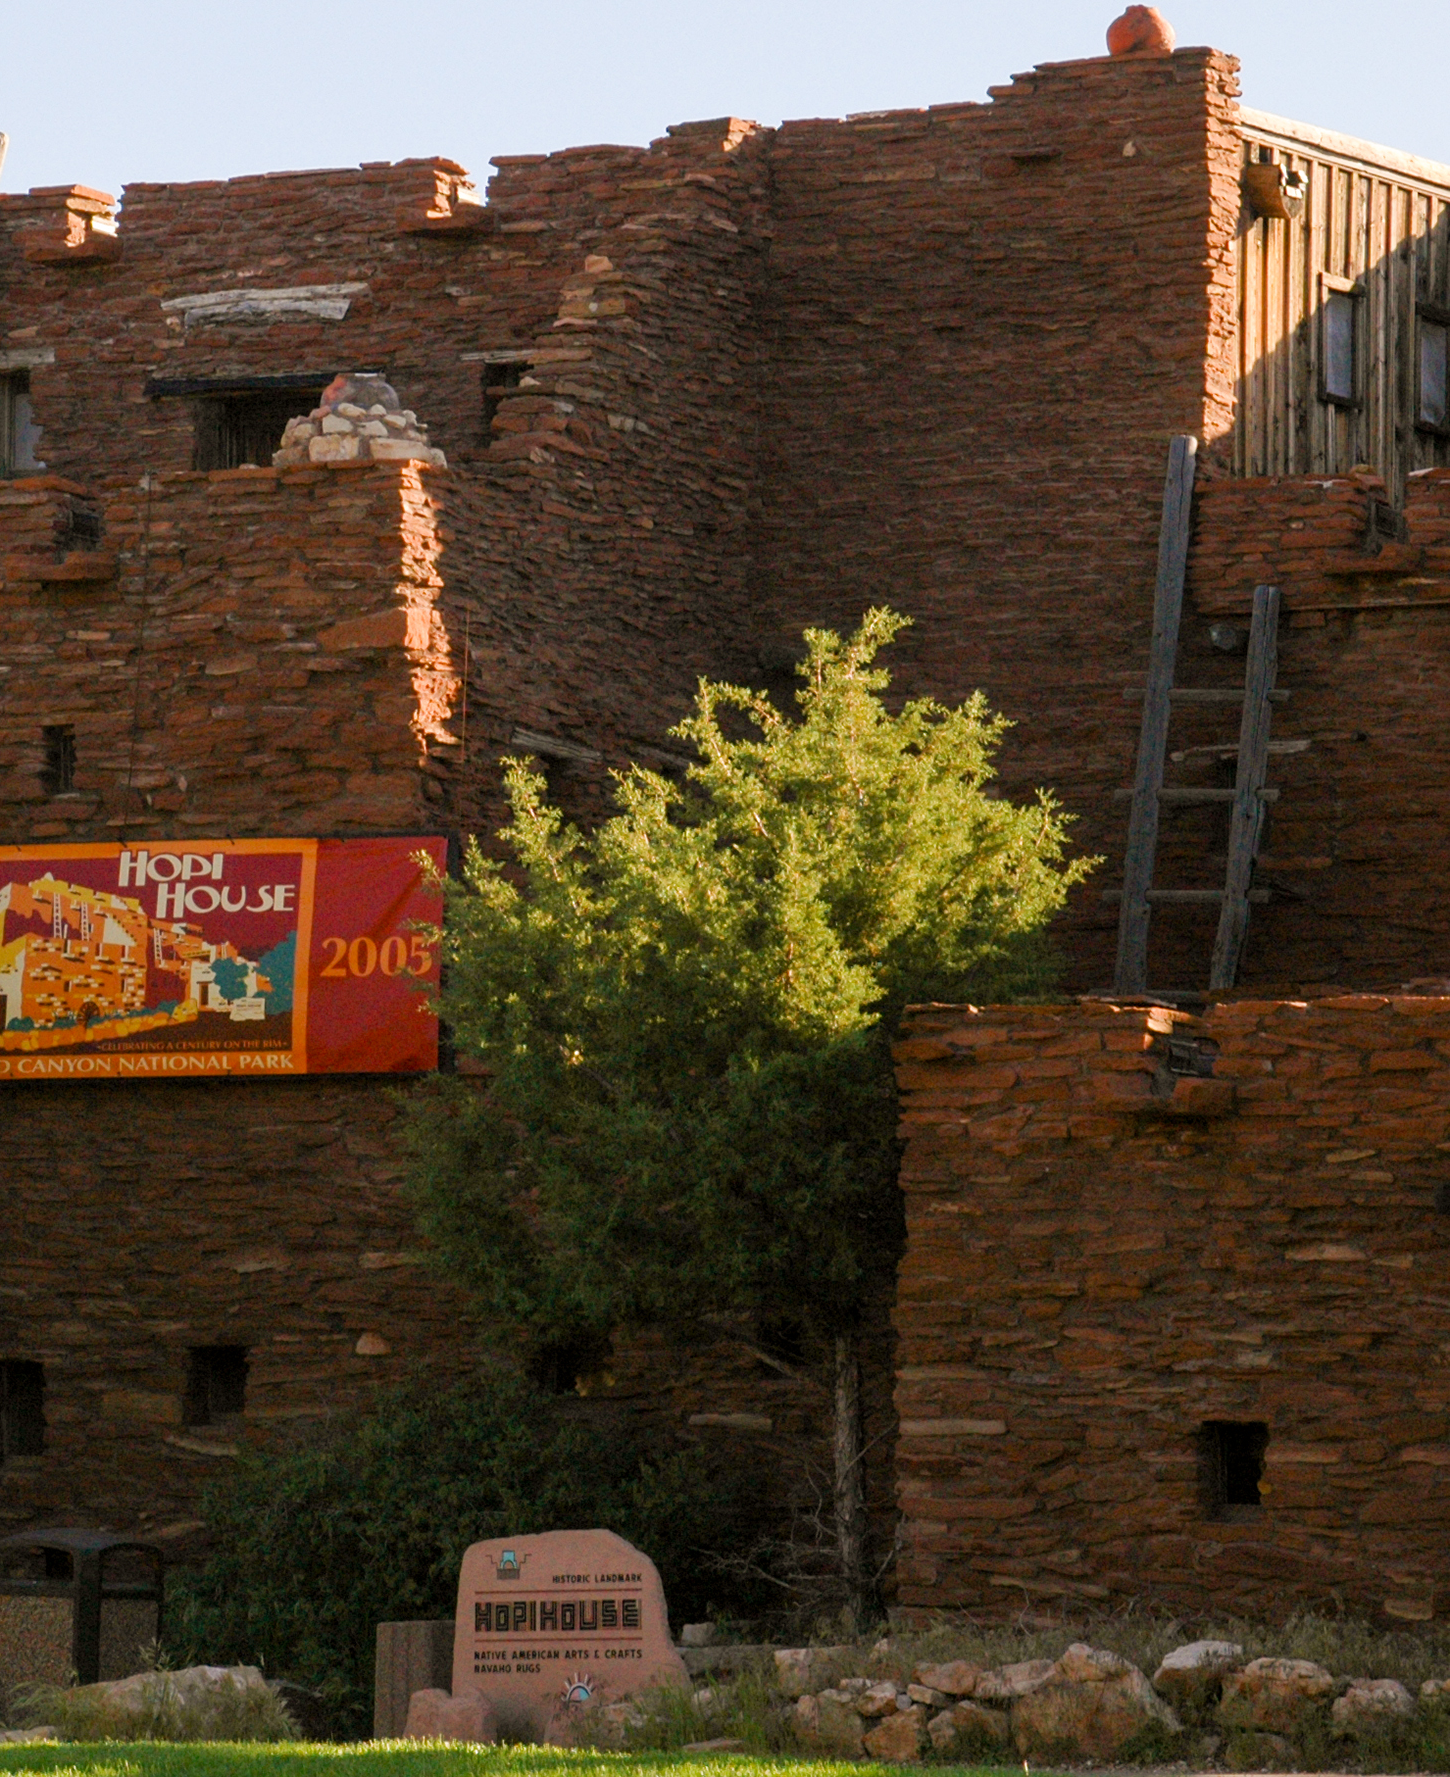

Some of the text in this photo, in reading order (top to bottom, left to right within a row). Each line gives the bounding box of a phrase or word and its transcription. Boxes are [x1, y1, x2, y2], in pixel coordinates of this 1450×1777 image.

[118, 851, 224, 887] HOPI
[155, 882, 296, 919] HOUSE
[319, 936, 433, 978] 2005
[101, 1041, 164, 1051] CELEBRATING
[166, 1041, 174, 1050] A
[176, 1040, 221, 1050] CENTURY
[223, 1040, 240, 1049] ON
[242, 1039, 259, 1049] THE
[17, 1057, 112, 1074] CANYON
[119, 1055, 232, 1072] NATIONAL
[239, 1054, 294, 1070] PARK
[552, 1572, 642, 1584] HISTORIC LANDMARK
[474, 1650, 507, 1661] NATIVE
[511, 1649, 560, 1660] AMERICAN
[564, 1649, 589, 1660] ARTS
[604, 1648, 643, 1659] CRAFTS
[474, 1663, 541, 1674] NAVAHO RUGS
